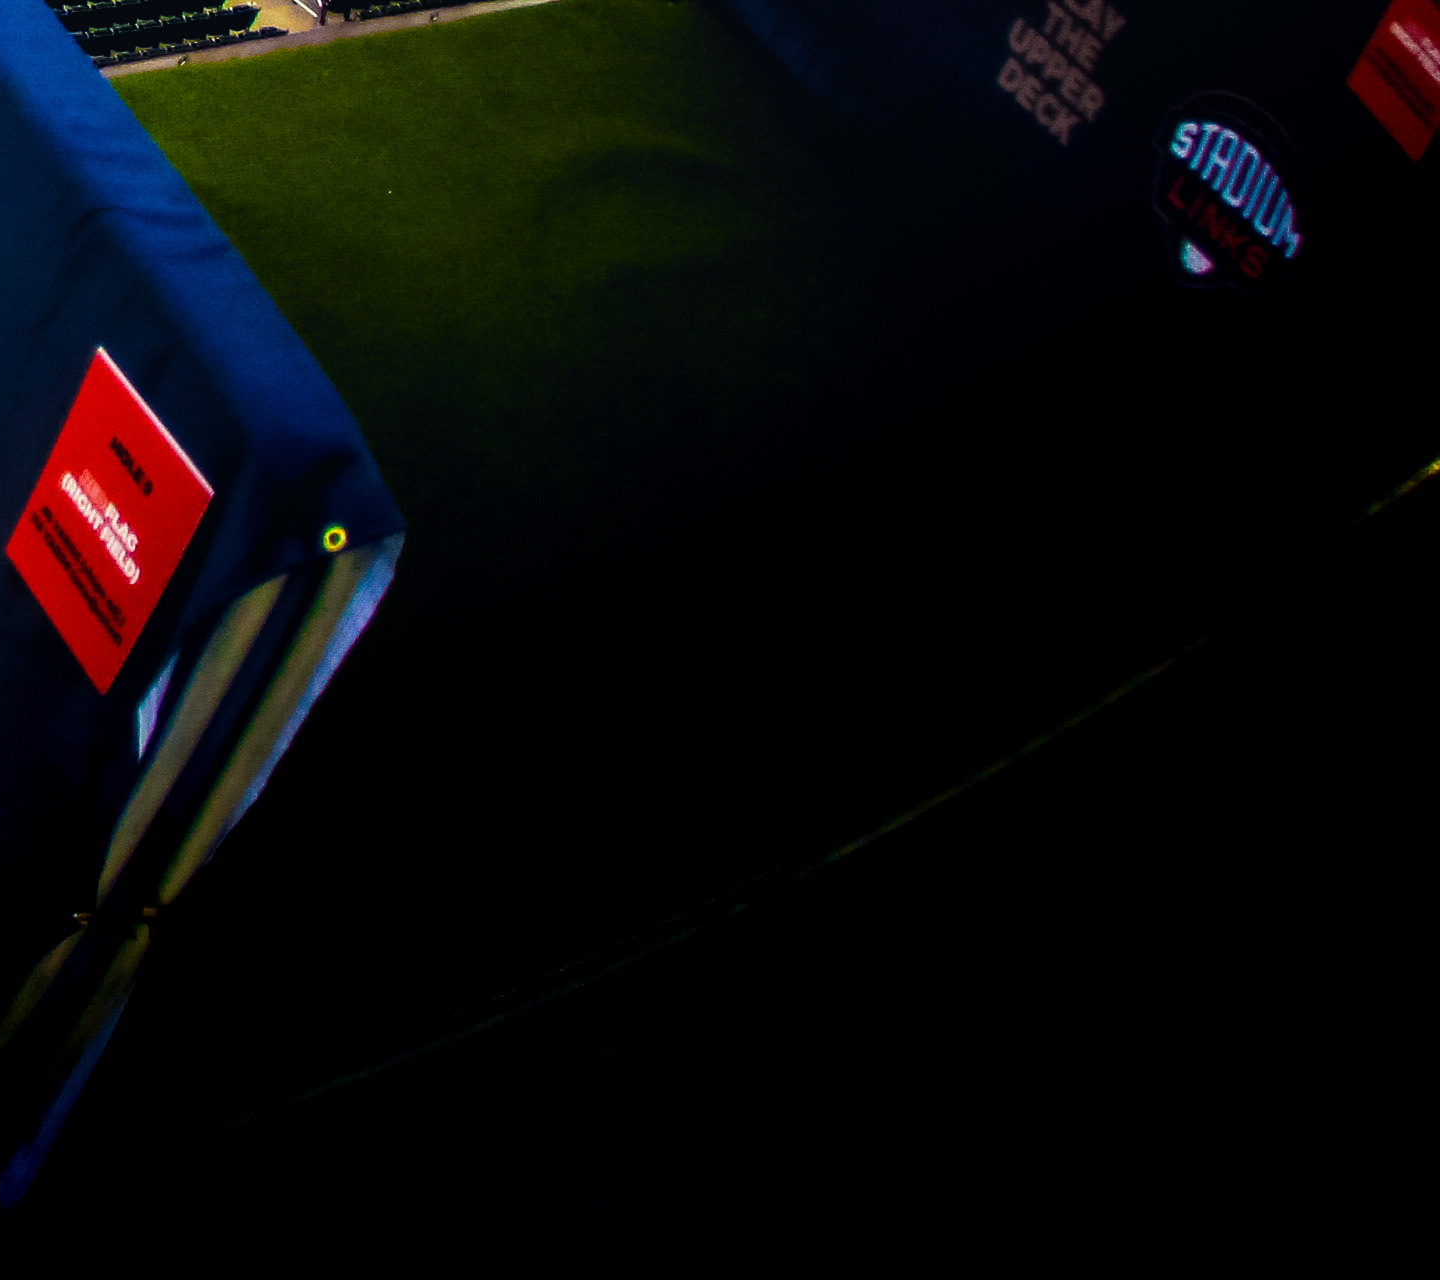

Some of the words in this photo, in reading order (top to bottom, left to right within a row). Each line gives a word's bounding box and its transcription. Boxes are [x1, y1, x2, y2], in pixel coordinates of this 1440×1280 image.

[1008, 16, 1107, 122] UPPER
[1046, 0, 1104, 73] THE
[996, 58, 1079, 147] DECK
[1167, 175, 1269, 280] LINKS
[1170, 121, 1303, 261] STADIUM
[104, 501, 139, 553] FLAG
